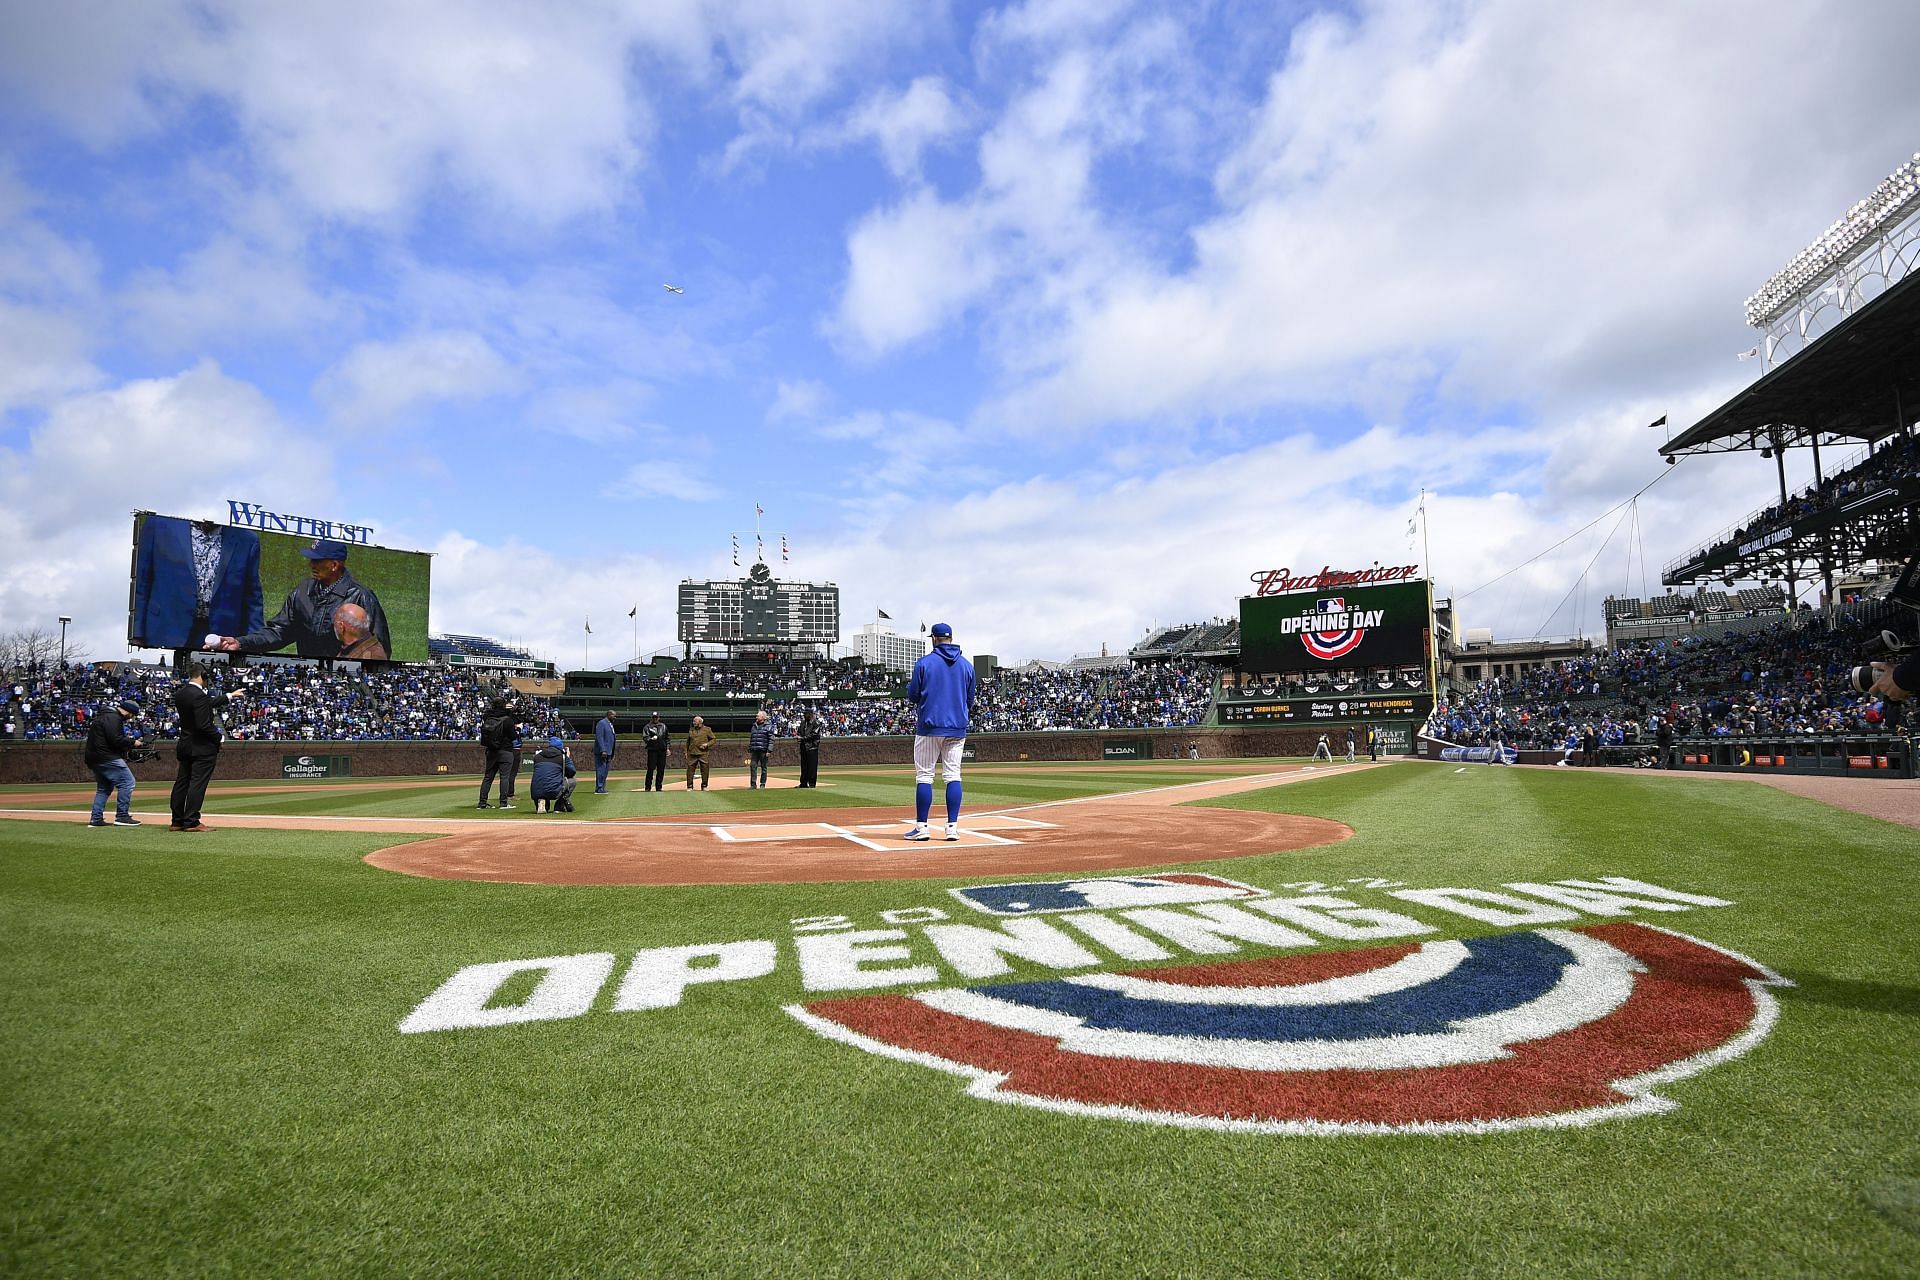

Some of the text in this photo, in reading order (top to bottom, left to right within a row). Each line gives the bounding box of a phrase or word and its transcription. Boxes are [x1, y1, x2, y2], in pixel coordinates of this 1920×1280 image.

[227, 500, 374, 544] WINTRUST
[1739, 526, 1793, 556] CUBS HALL OF FAMERS
[1250, 561, 1418, 596] Budweiser
[1302, 604, 1360, 616] 20 22
[1281, 610, 1384, 634] OPENING DAY
[1616, 617, 1686, 627] WRIGLEYROOFTOPS.COM
[464, 656, 534, 668] WRIGLEYROOFTOPS.COM
[856, 688, 891, 697] Budweiser
[1311, 702, 1334, 712] Starting
[1311, 710, 1334, 718] Pitchers
[1104, 747, 1135, 755] SLOAN
[284, 765, 327, 774] Gallagher
[399, 876, 1736, 1034] OPENING DAY
